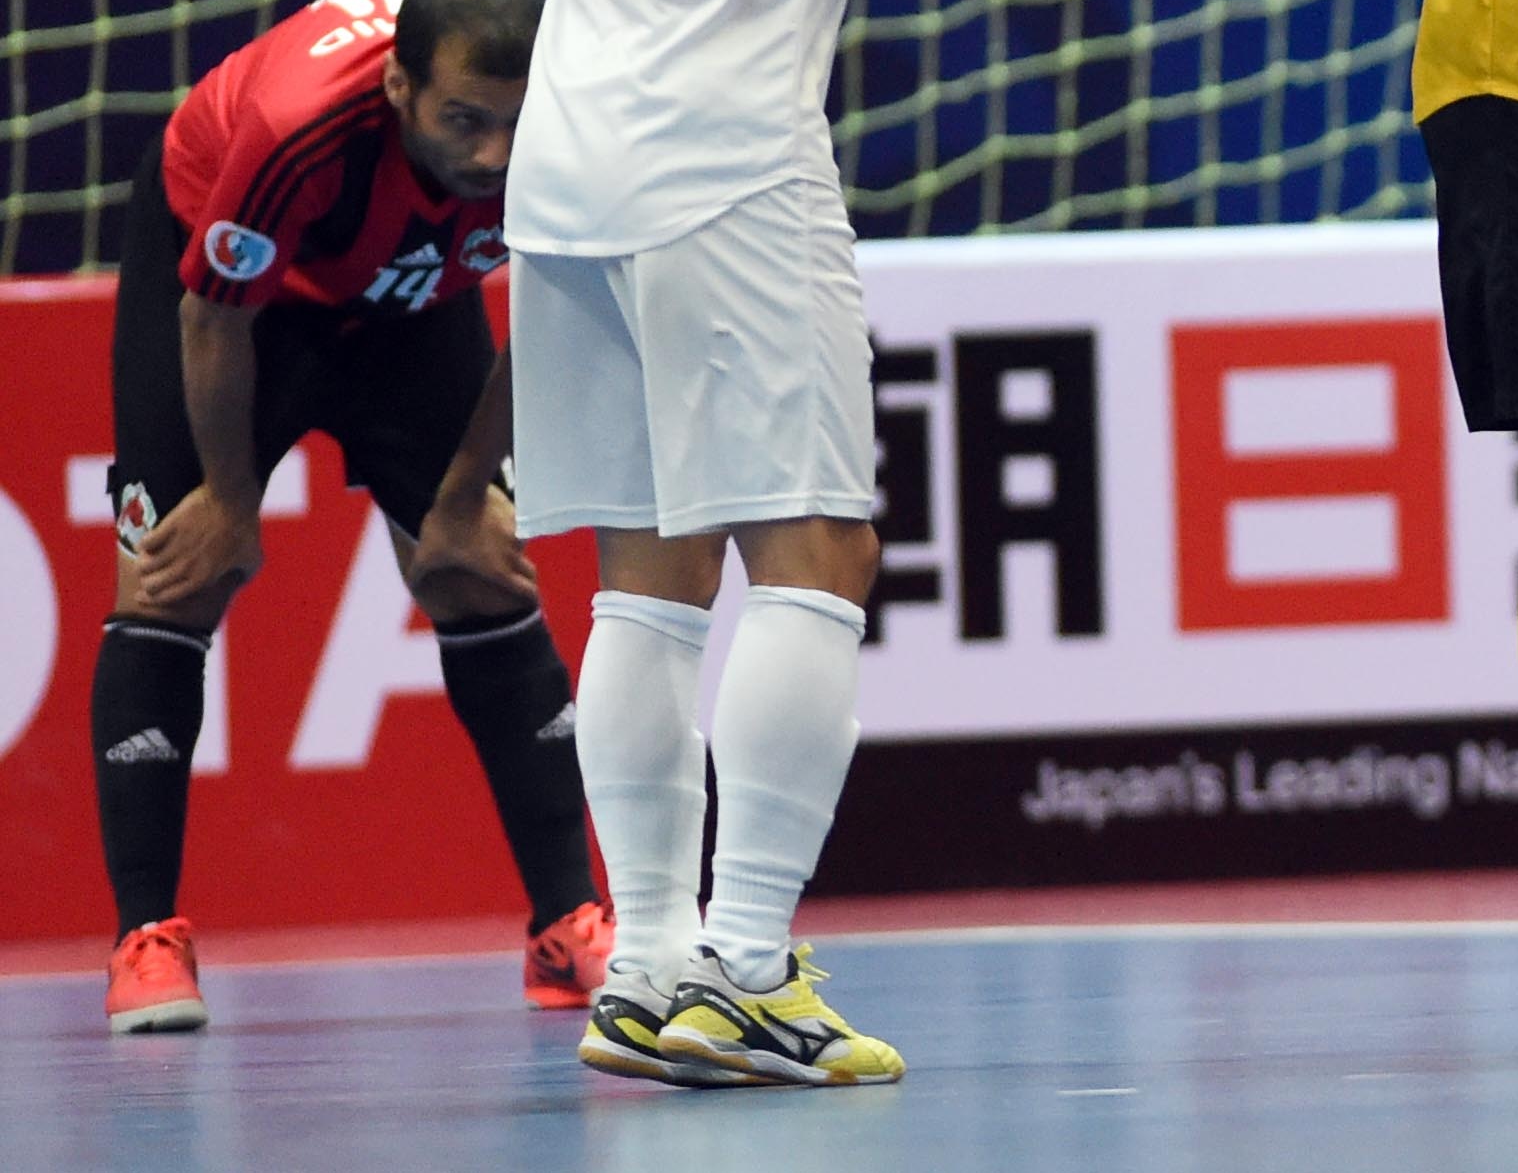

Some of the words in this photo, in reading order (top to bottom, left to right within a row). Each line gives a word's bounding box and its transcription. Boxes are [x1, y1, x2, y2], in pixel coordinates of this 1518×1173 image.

[363, 266, 444, 311] 14
[1021, 755, 1226, 827] Japan's
[1234, 745, 1452, 820] Leading
